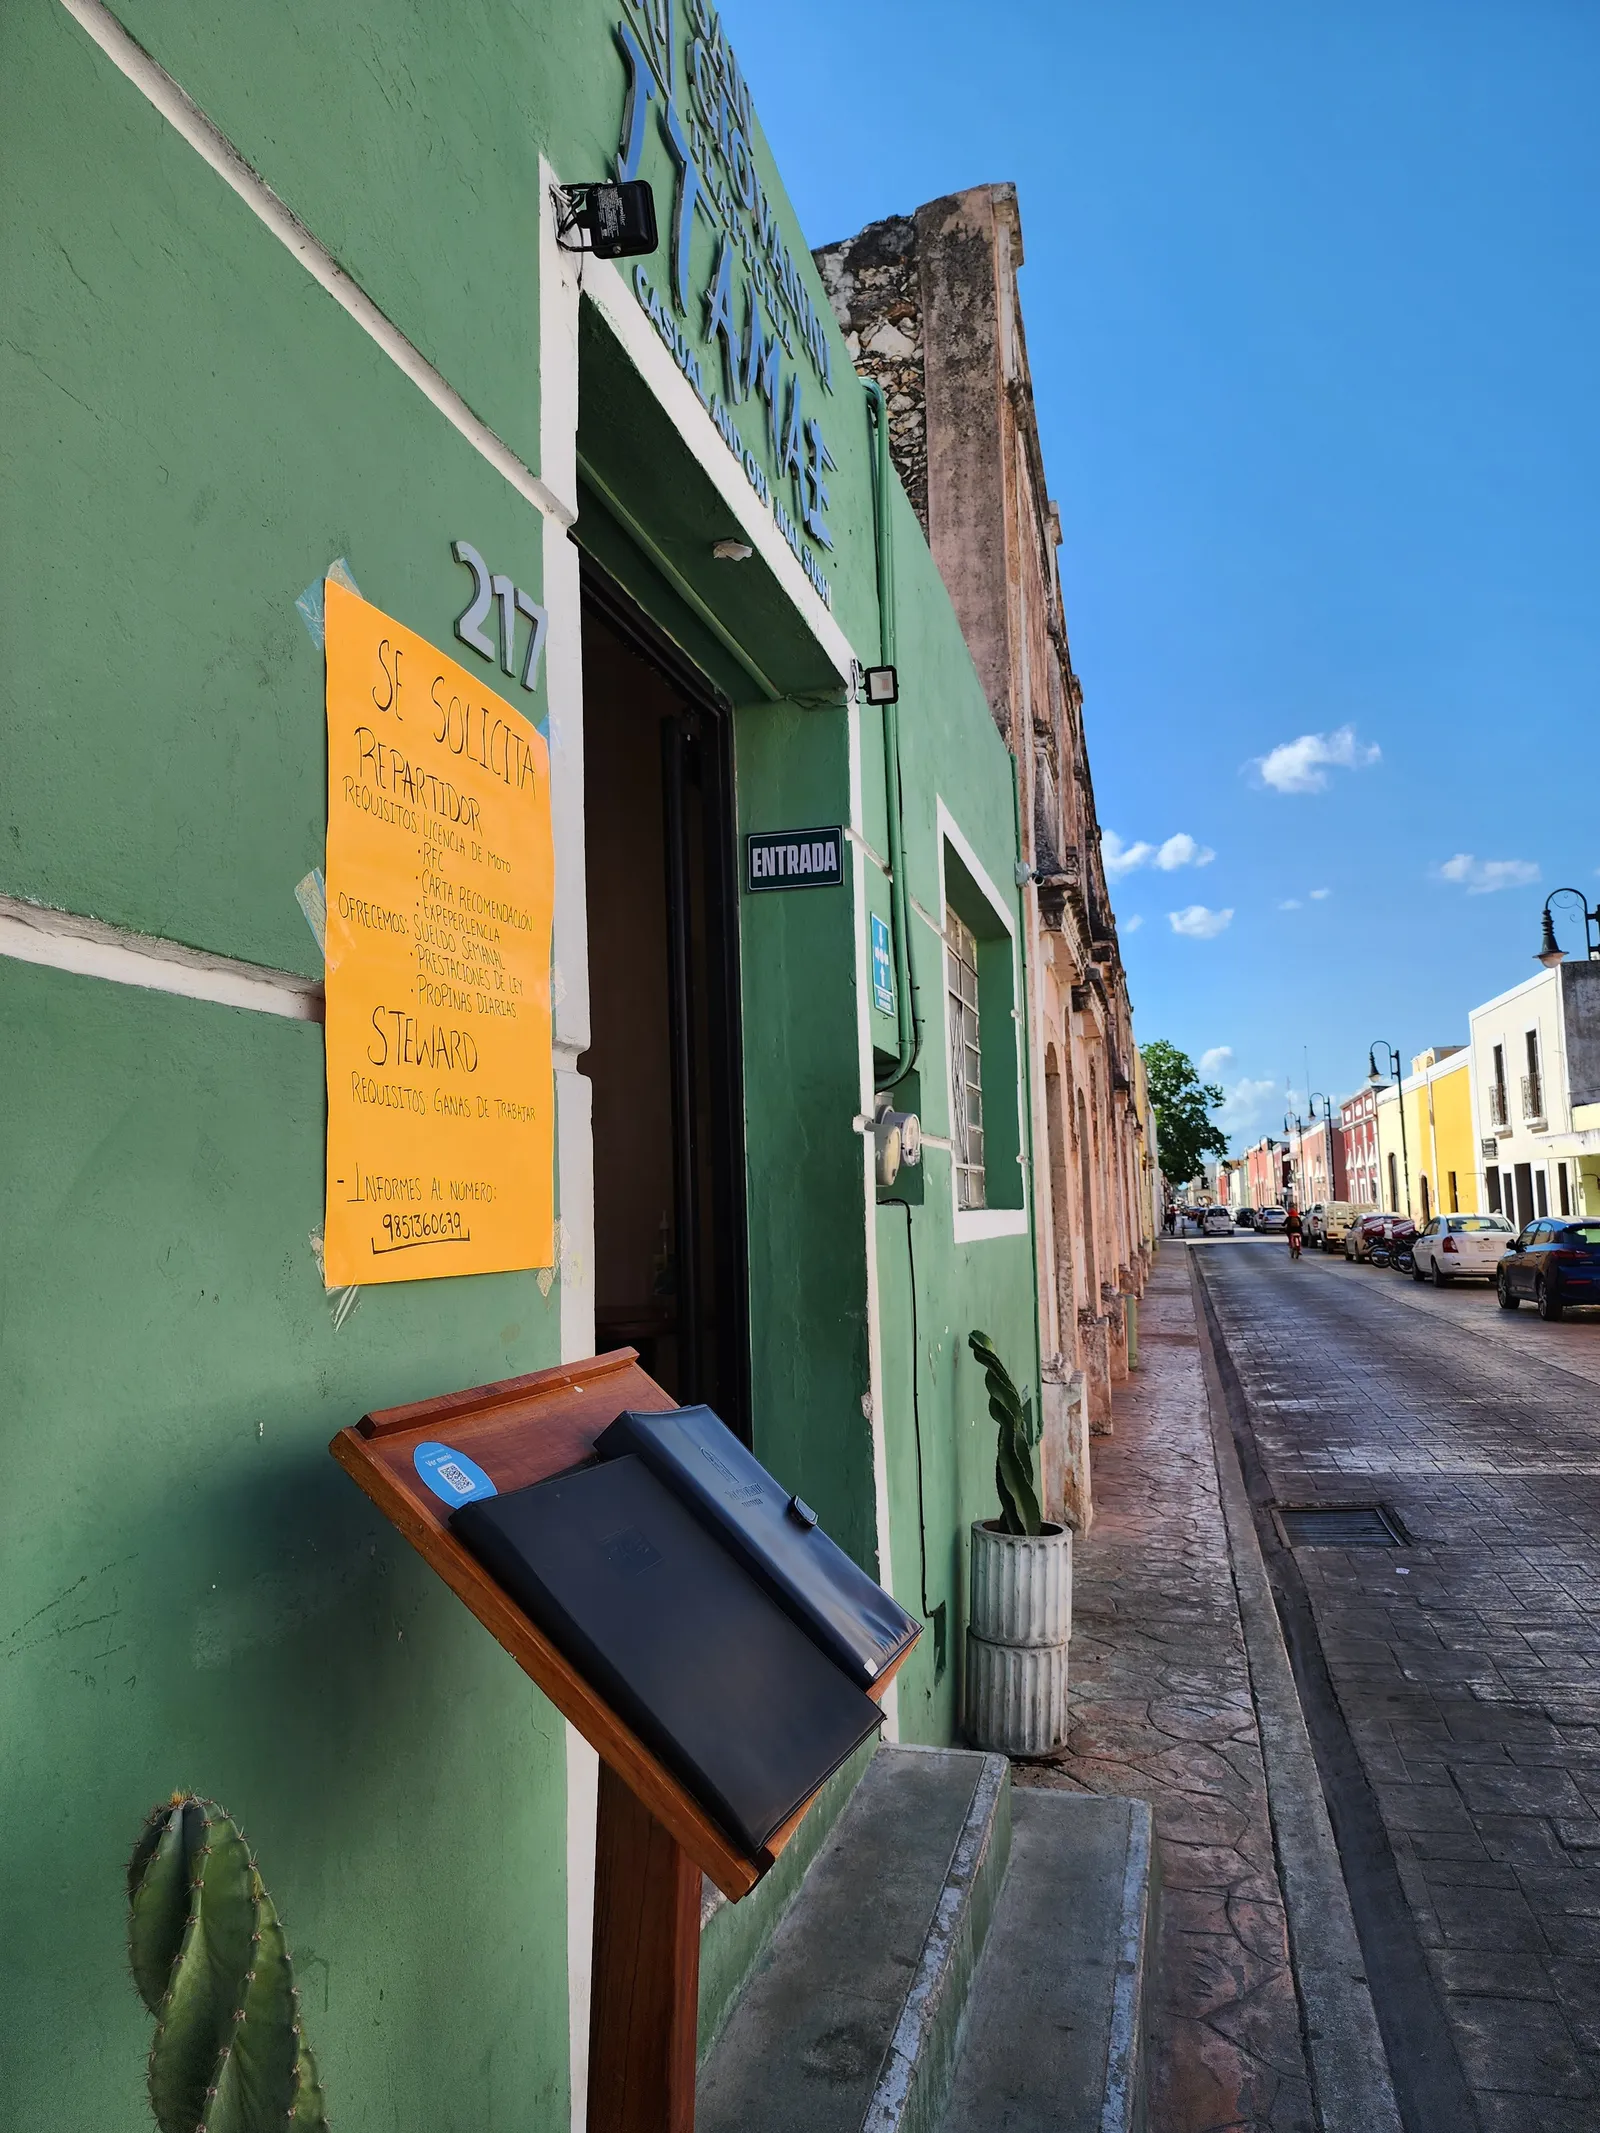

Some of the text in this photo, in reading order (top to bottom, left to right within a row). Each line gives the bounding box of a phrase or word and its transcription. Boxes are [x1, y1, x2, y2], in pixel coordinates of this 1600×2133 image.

[687, 109, 794, 359] TRATTORIA
[690, 37, 833, 396] GIOVANNI
[633, 264, 709, 410] CASUAL
[710, 393, 743, 463] AND
[451, 541, 549, 692] 217
[372, 639, 536, 800] SE SOLICITA
[354, 727, 483, 836] REPARTIDOR
[343, 776, 512, 874] REQUISITOS: LICENCIA DE MOTO
[423, 842, 444, 872] RFC
[752, 841, 838, 878] ENTRADA
[338, 892, 506, 970] OFRECEMOS: SUELDO SEMANAL
[422, 869, 533, 932] CARTA RECOMENDACIÓN
[415, 944, 524, 996] PRESTACIONES DE LEY
[416, 974, 473, 1013] PROPINAS
[367, 1006, 478, 1072] STEWARD
[351, 1071, 536, 1123] REQUISITOS: GANAS DE TRABAJAR
[347, 1162, 422, 1202] INFORMES
[431, 1177, 443, 1201] AL
[382, 1212, 462, 1242] 9851360679
